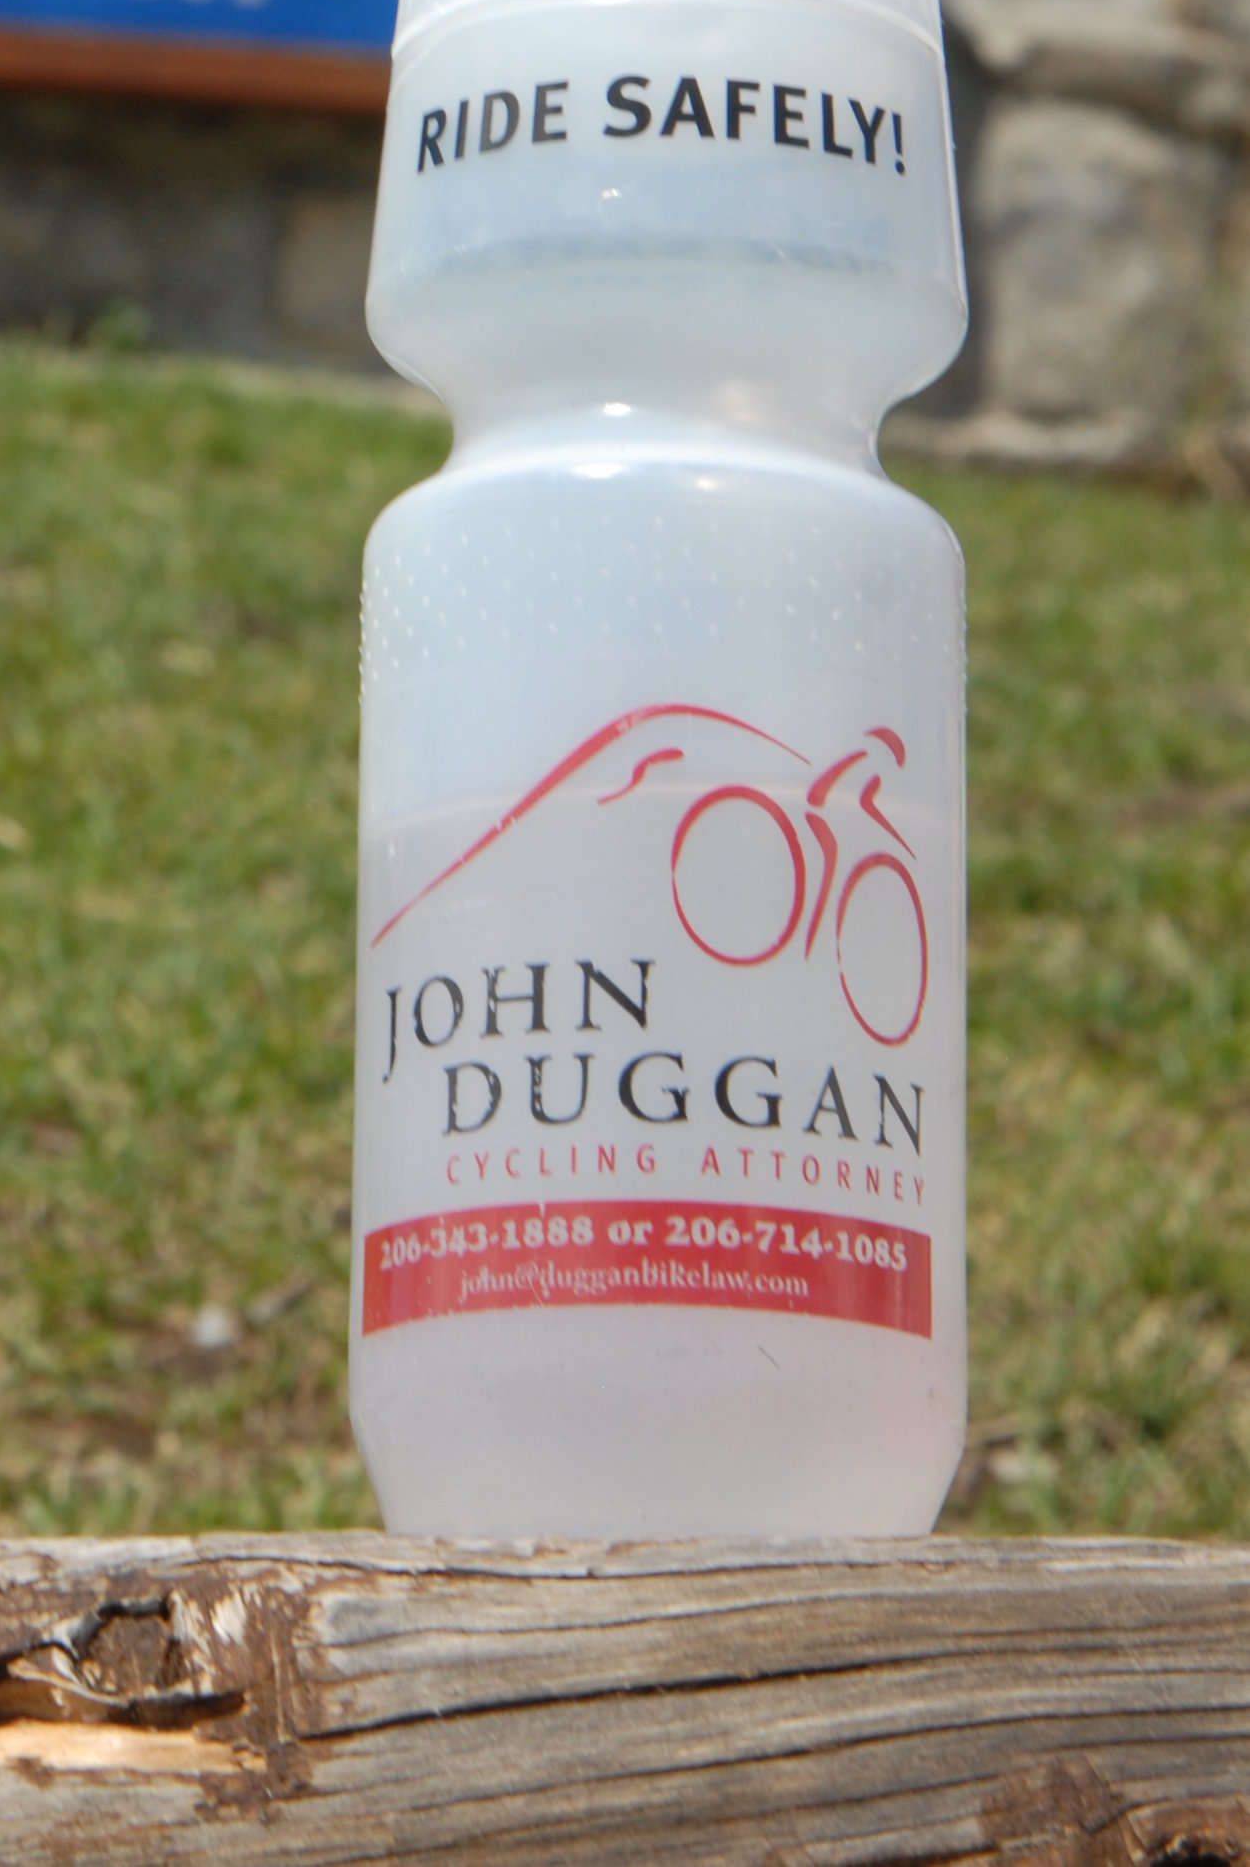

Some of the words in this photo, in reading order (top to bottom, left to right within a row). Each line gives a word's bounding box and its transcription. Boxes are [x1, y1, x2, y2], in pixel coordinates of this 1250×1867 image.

[417, 80, 569, 173] RIDE
[603, 75, 906, 175] SAFELY!
[382, 959, 654, 1084] JOHN
[442, 1052, 924, 1156] DUGGAN
[446, 1142, 657, 1186] CYCLING
[700, 1145, 925, 1206] ATTORNEY
[380, 1214, 595, 1271] 206-343-1888
[607, 1219, 654, 1247] or
[664, 1215, 908, 1272] 206-714-1085
